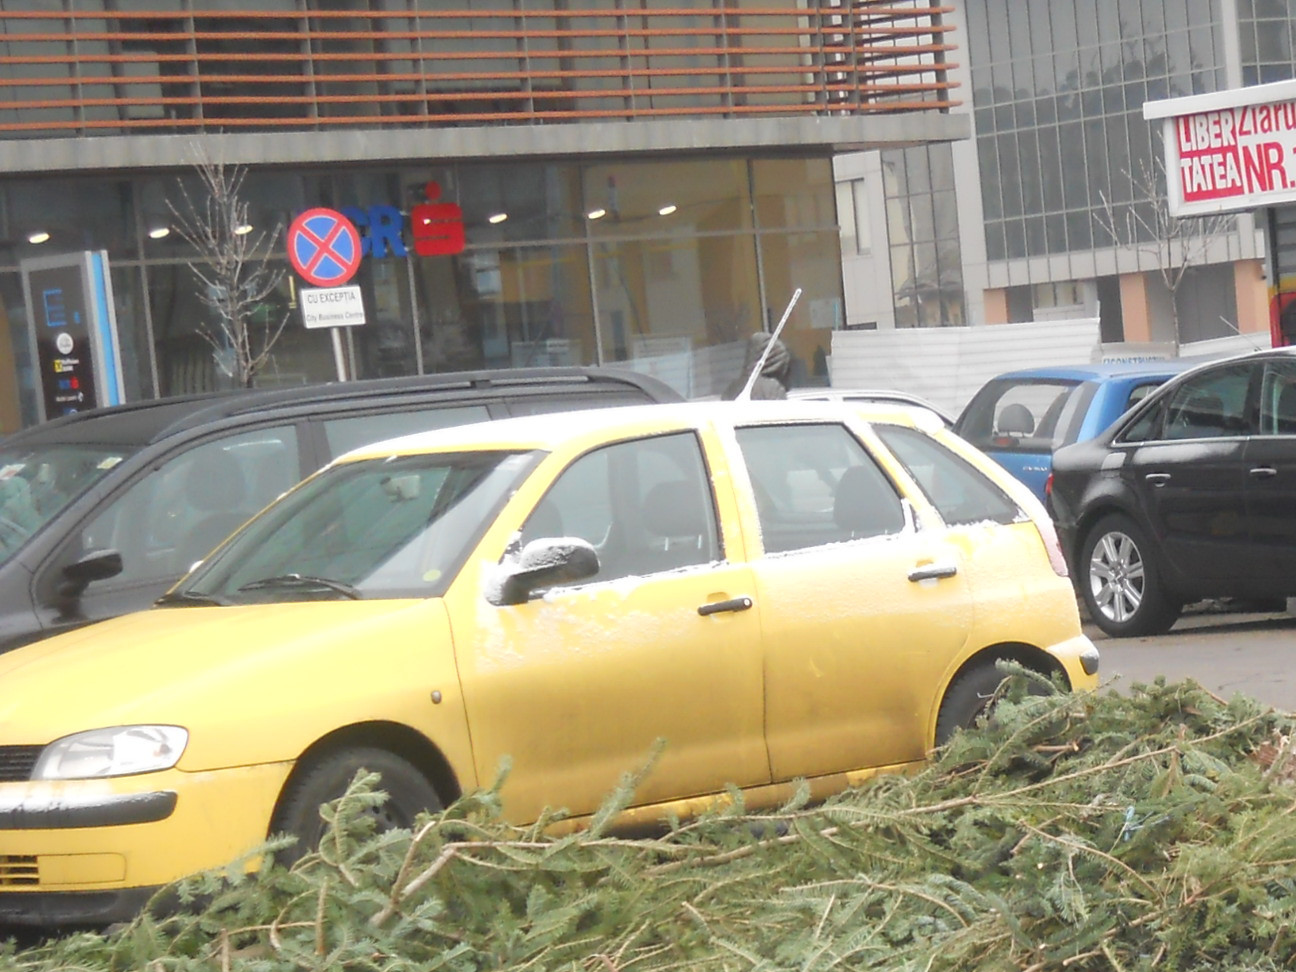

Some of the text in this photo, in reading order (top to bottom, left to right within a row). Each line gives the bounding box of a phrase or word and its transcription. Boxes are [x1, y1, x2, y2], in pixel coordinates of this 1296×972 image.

[1179, 111, 1236, 152] LIBER
[1180, 151, 1242, 193] TATEA
[307, 294, 318, 304] CU
[306, 314, 317, 322] City
[318, 312, 343, 321] Business
